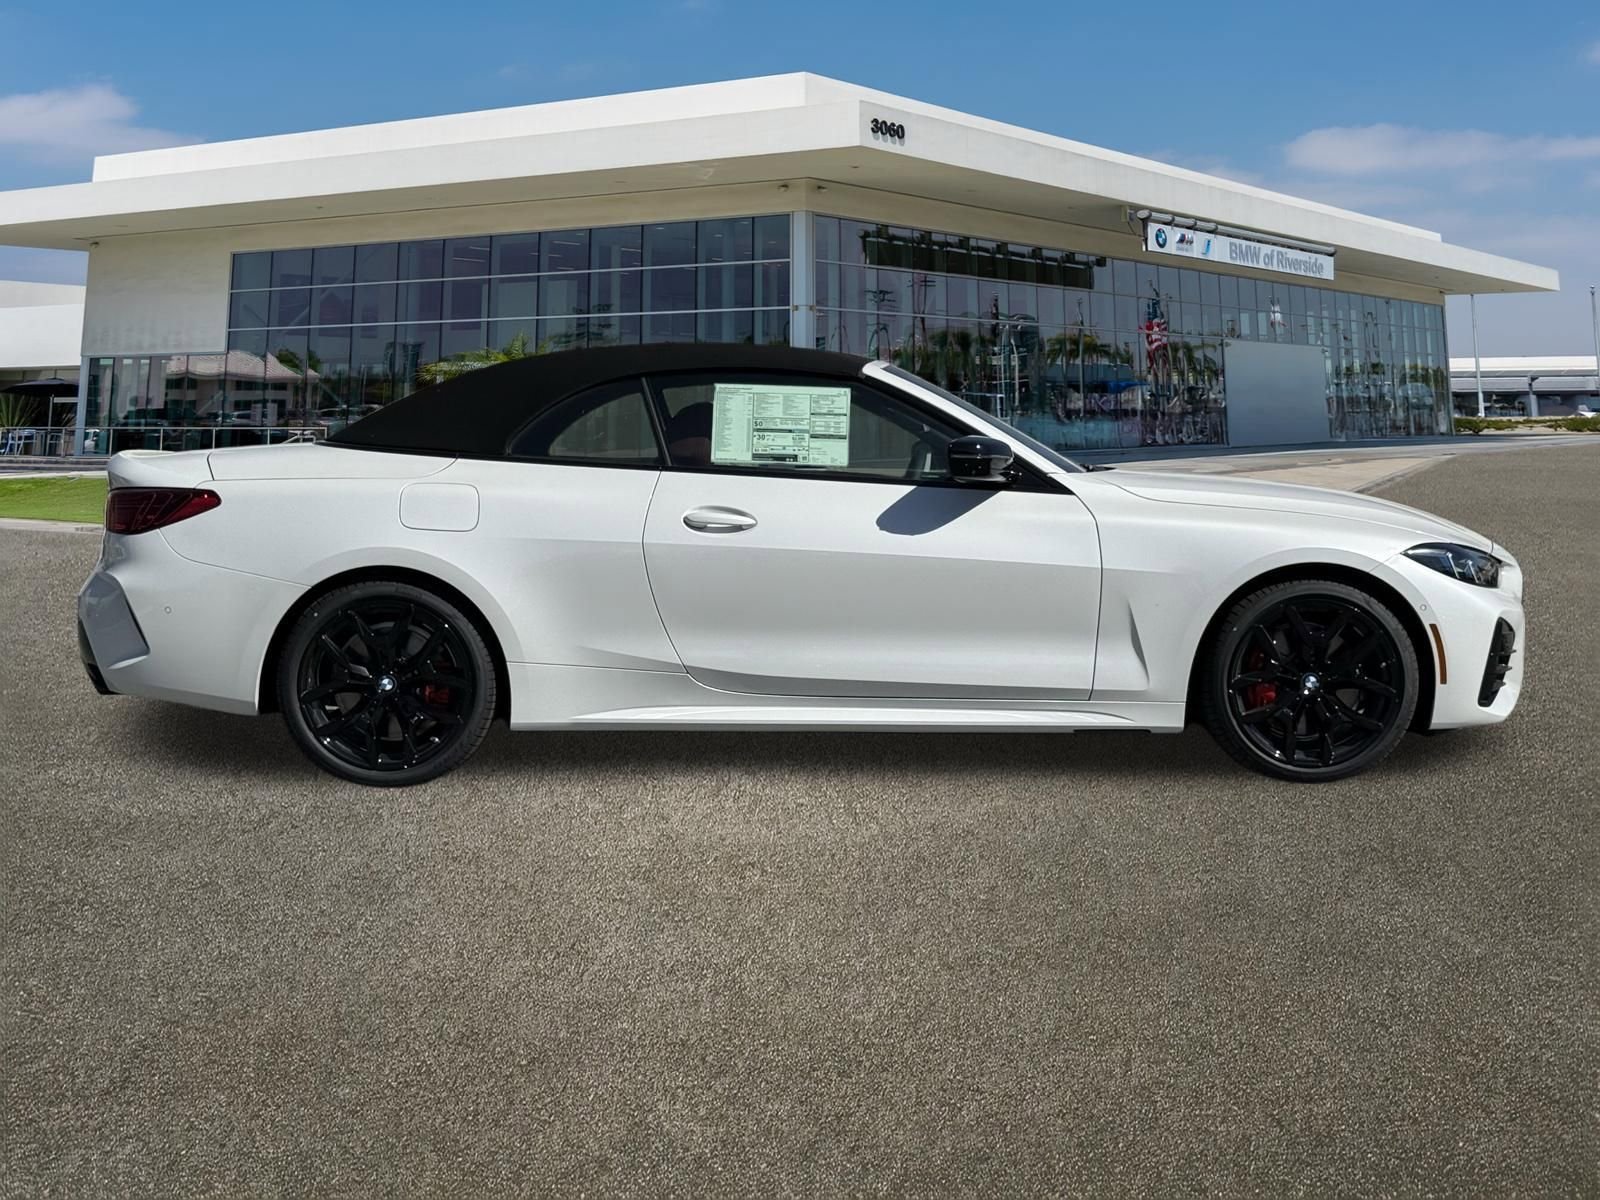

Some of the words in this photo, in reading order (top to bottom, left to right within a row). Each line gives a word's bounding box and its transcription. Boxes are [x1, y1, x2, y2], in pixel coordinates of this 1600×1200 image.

[871, 118, 905, 139] 3060
[1229, 242, 1260, 265] BMW
[1263, 249, 1275, 267] of
[1276, 251, 1324, 275] Riverside
